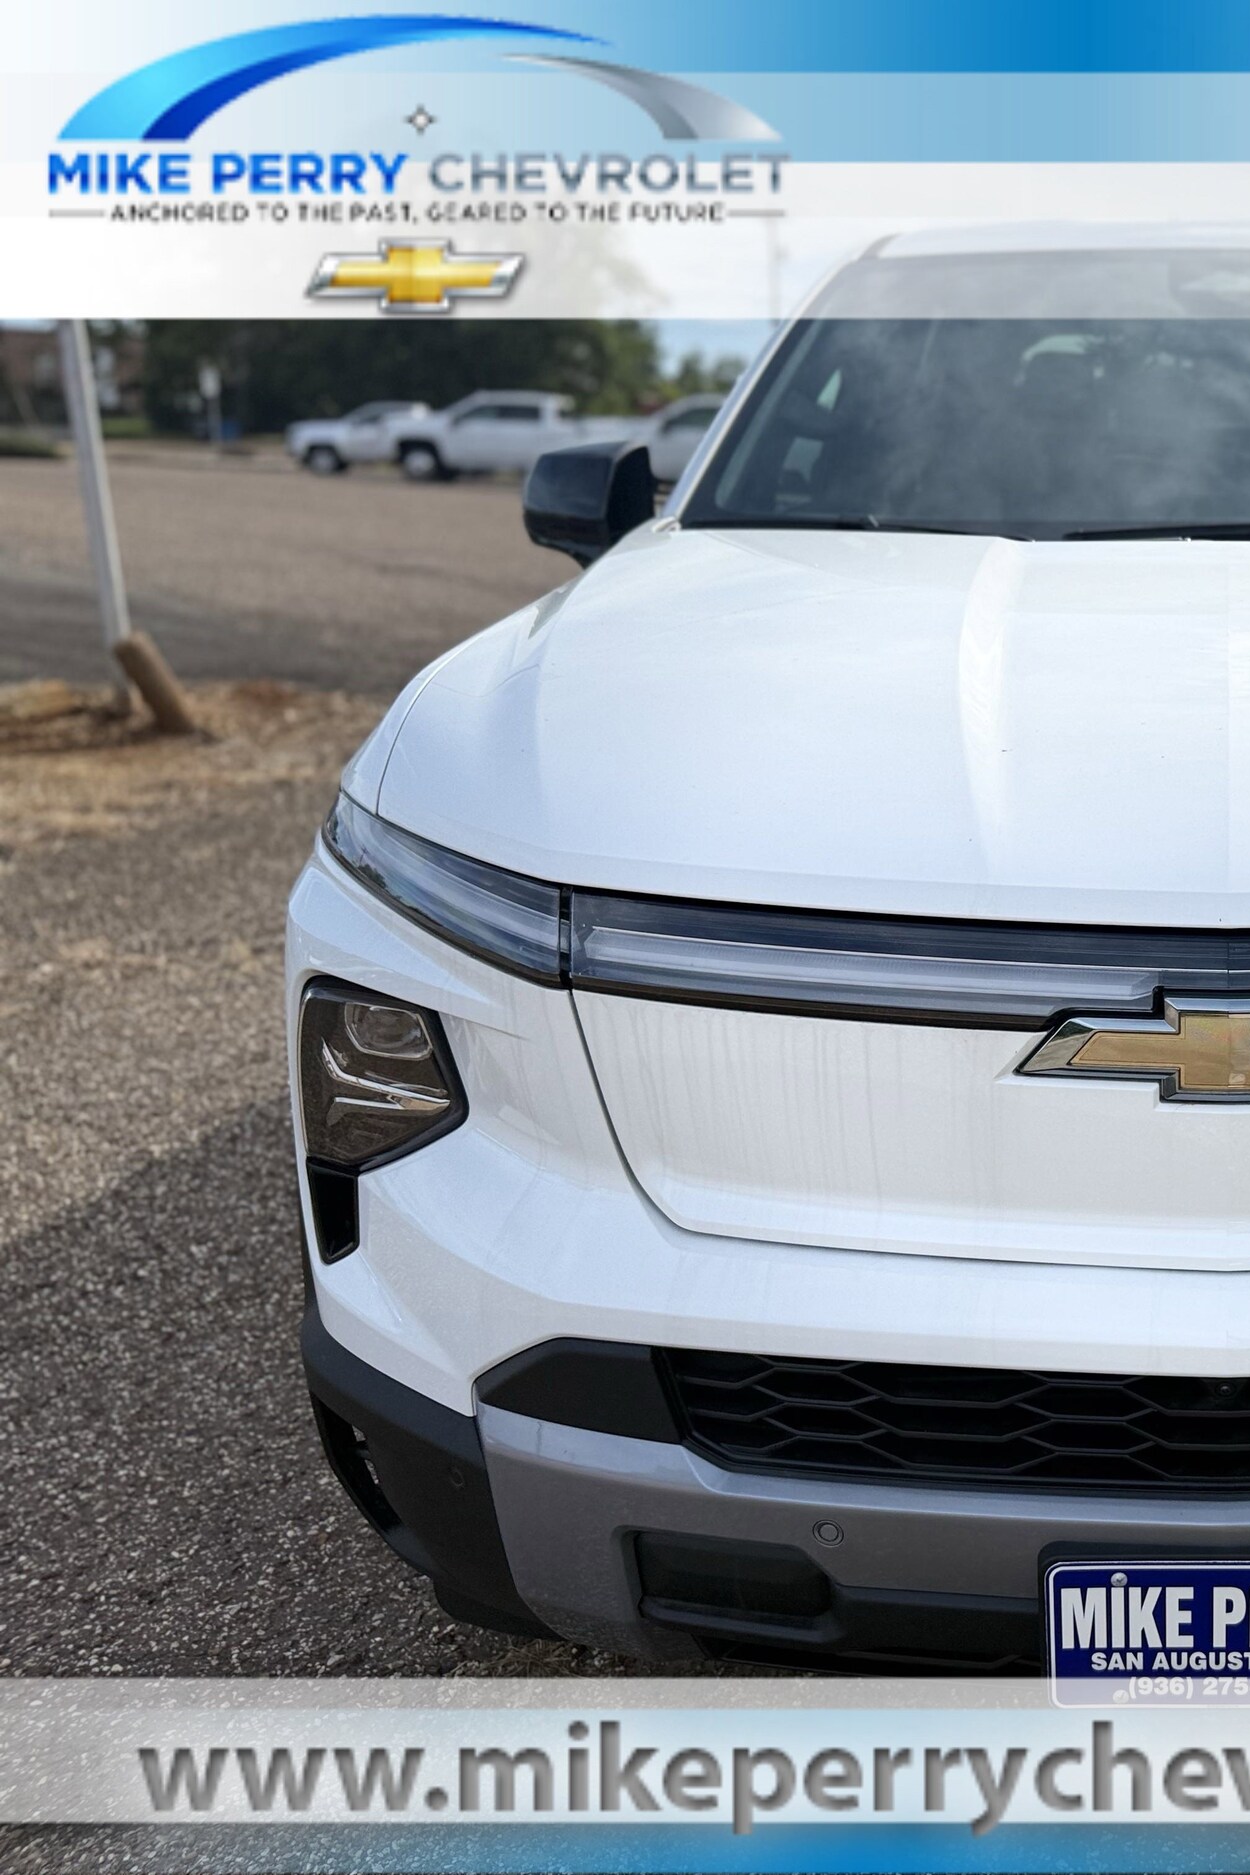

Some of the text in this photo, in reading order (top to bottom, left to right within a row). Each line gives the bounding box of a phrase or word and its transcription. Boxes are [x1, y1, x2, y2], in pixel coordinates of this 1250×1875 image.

[1060, 1586, 1195, 1650] MIKE
[1091, 1651, 1144, 1671] SAN
[1128, 1676, 1194, 1699] (936)
